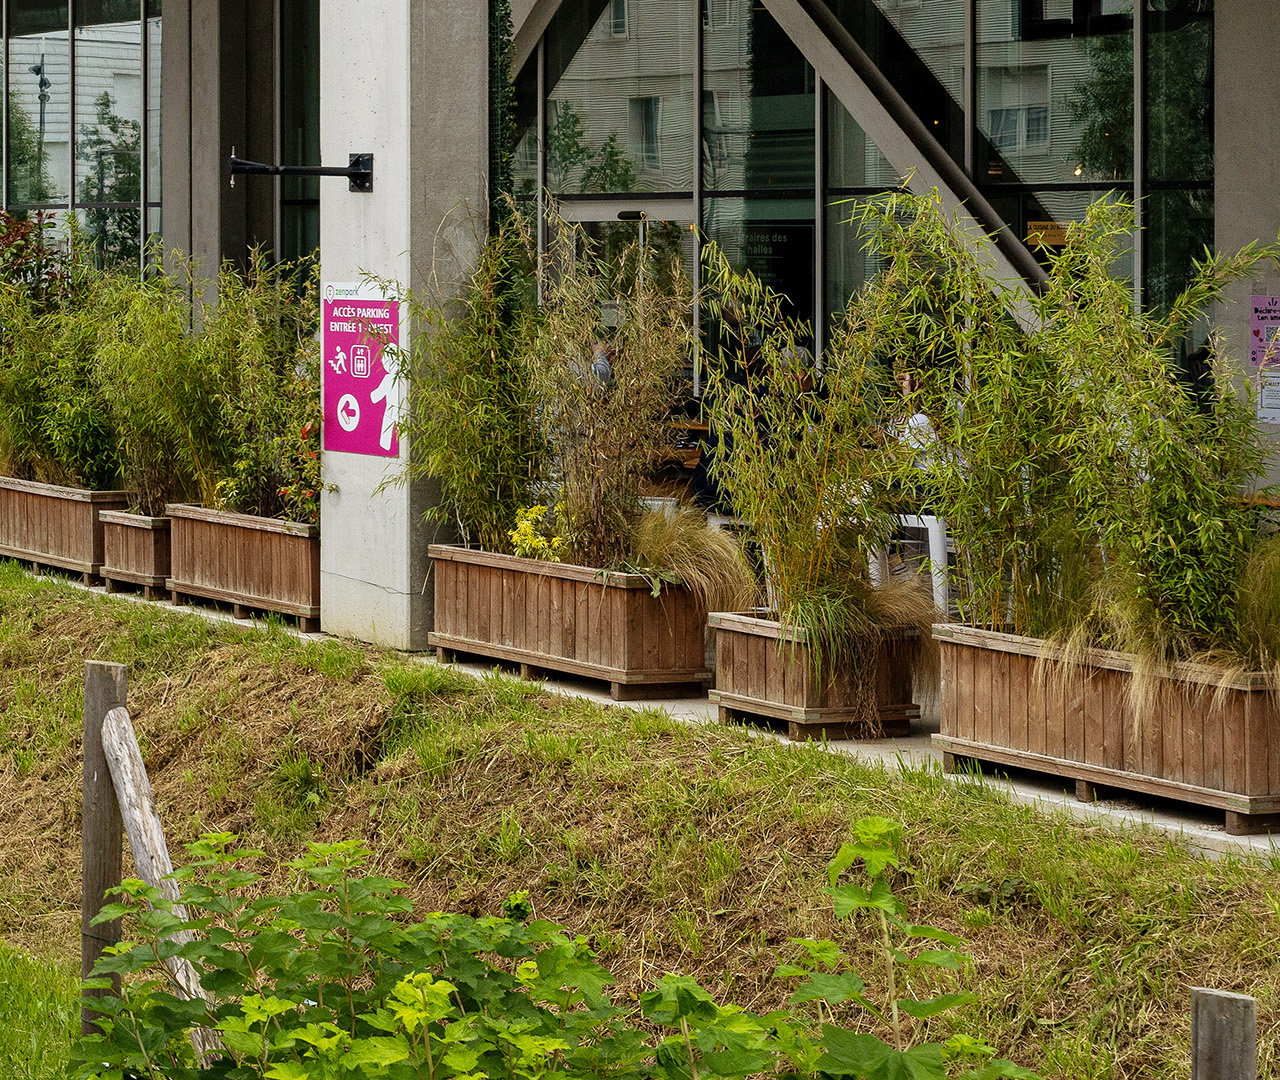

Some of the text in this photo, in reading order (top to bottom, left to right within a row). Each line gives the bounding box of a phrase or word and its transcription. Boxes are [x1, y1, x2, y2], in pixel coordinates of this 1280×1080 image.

[772, 232, 788, 242] des
[747, 244, 773, 255] halles
[335, 286, 360, 298] zenpark
[332, 305, 390, 319] ACCÈS PARKING
